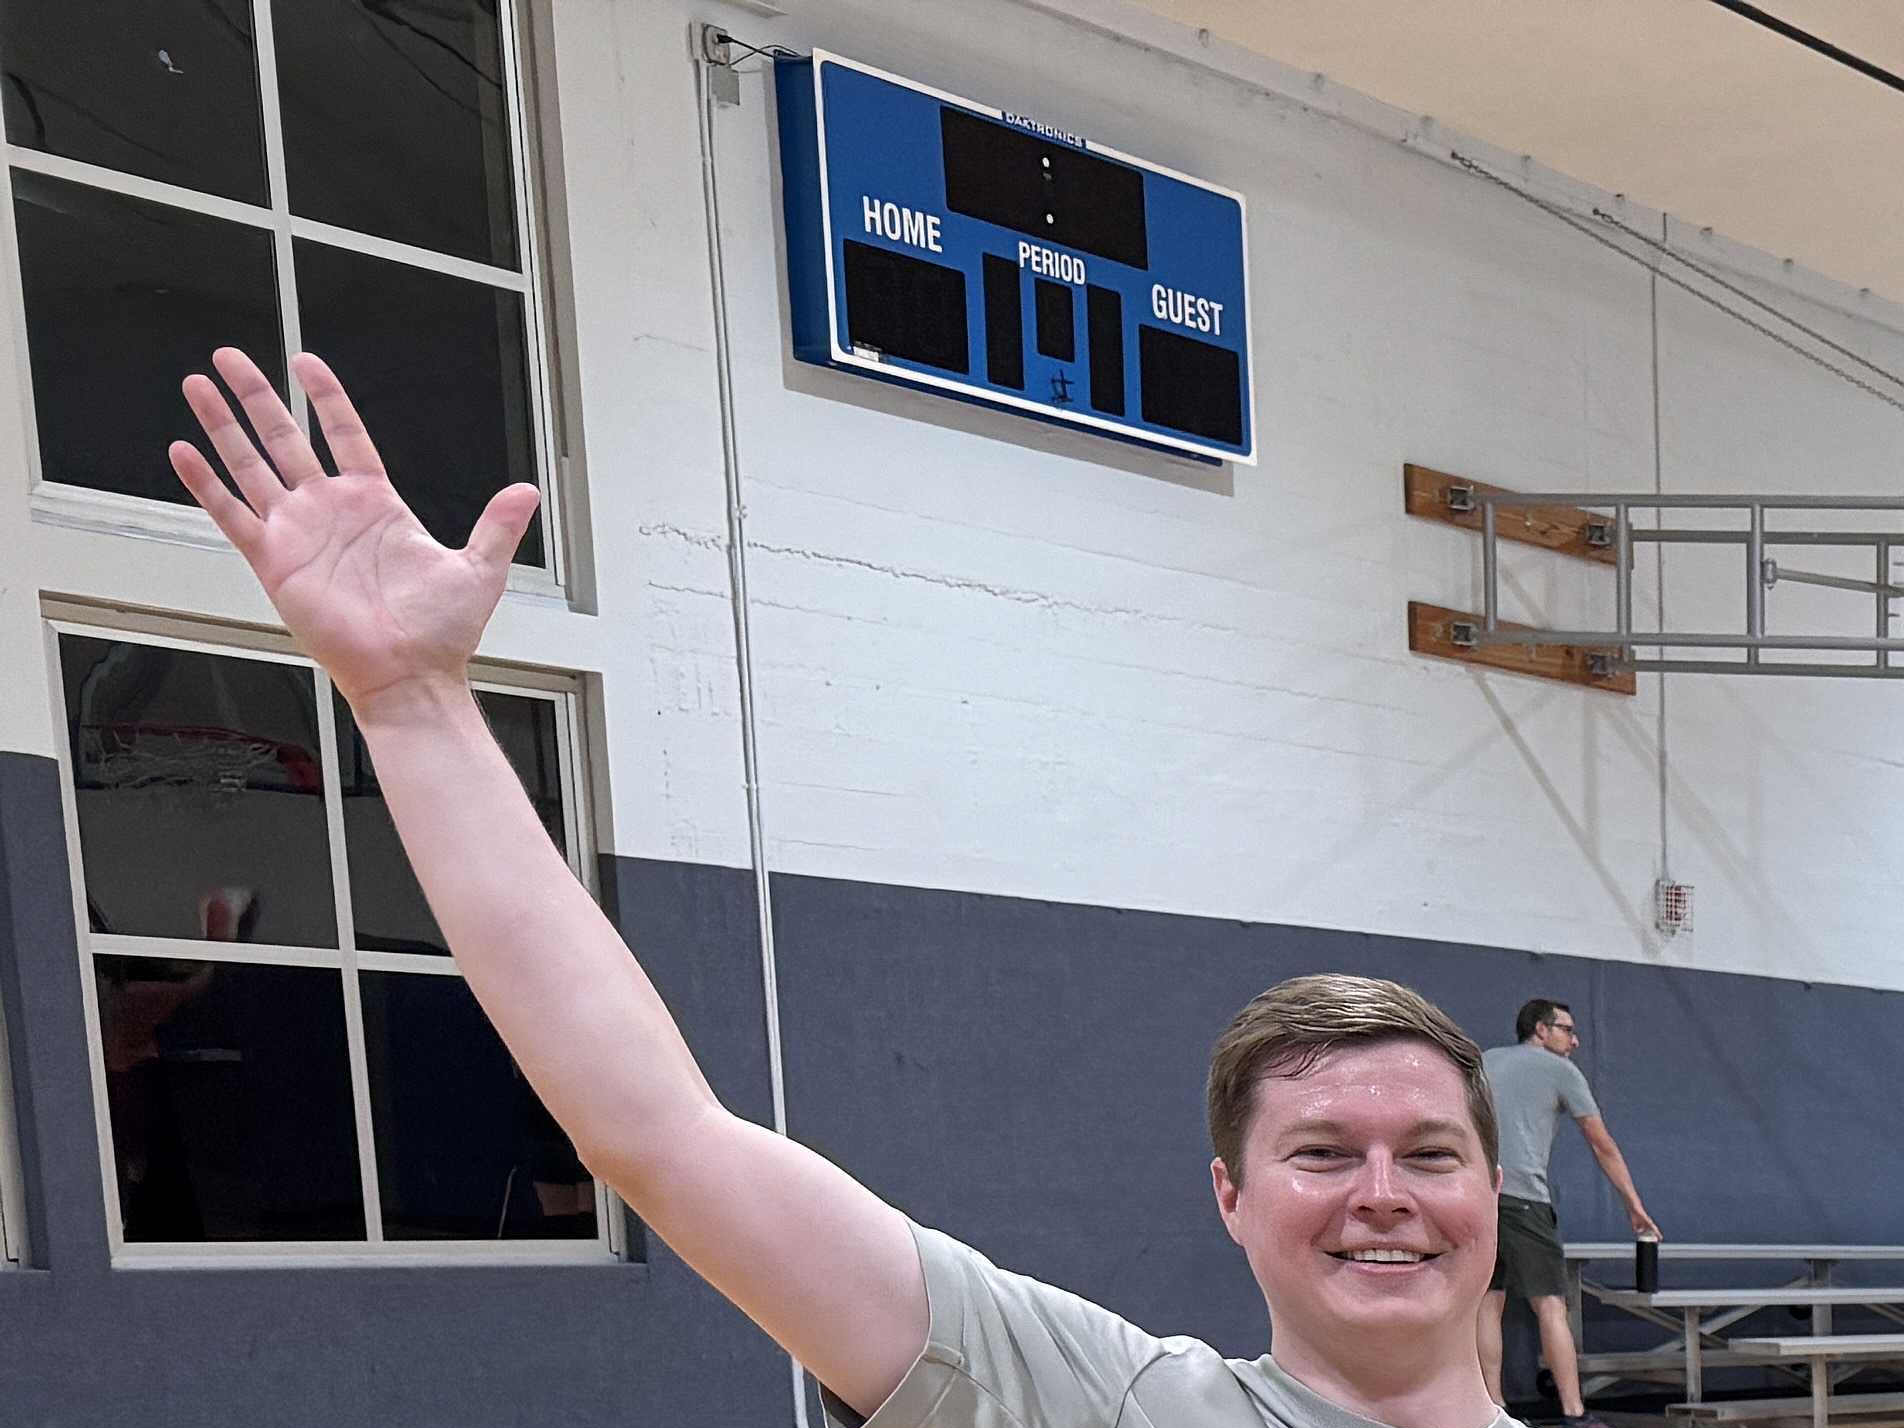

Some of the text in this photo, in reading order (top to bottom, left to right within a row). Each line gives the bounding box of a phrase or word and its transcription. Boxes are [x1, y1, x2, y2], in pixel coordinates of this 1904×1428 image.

[1006, 112, 1083, 147] DAKTRONICS
[862, 196, 943, 253] HOME
[1018, 241, 1086, 286] PERIOD
[1151, 284, 1223, 336] GUEST
